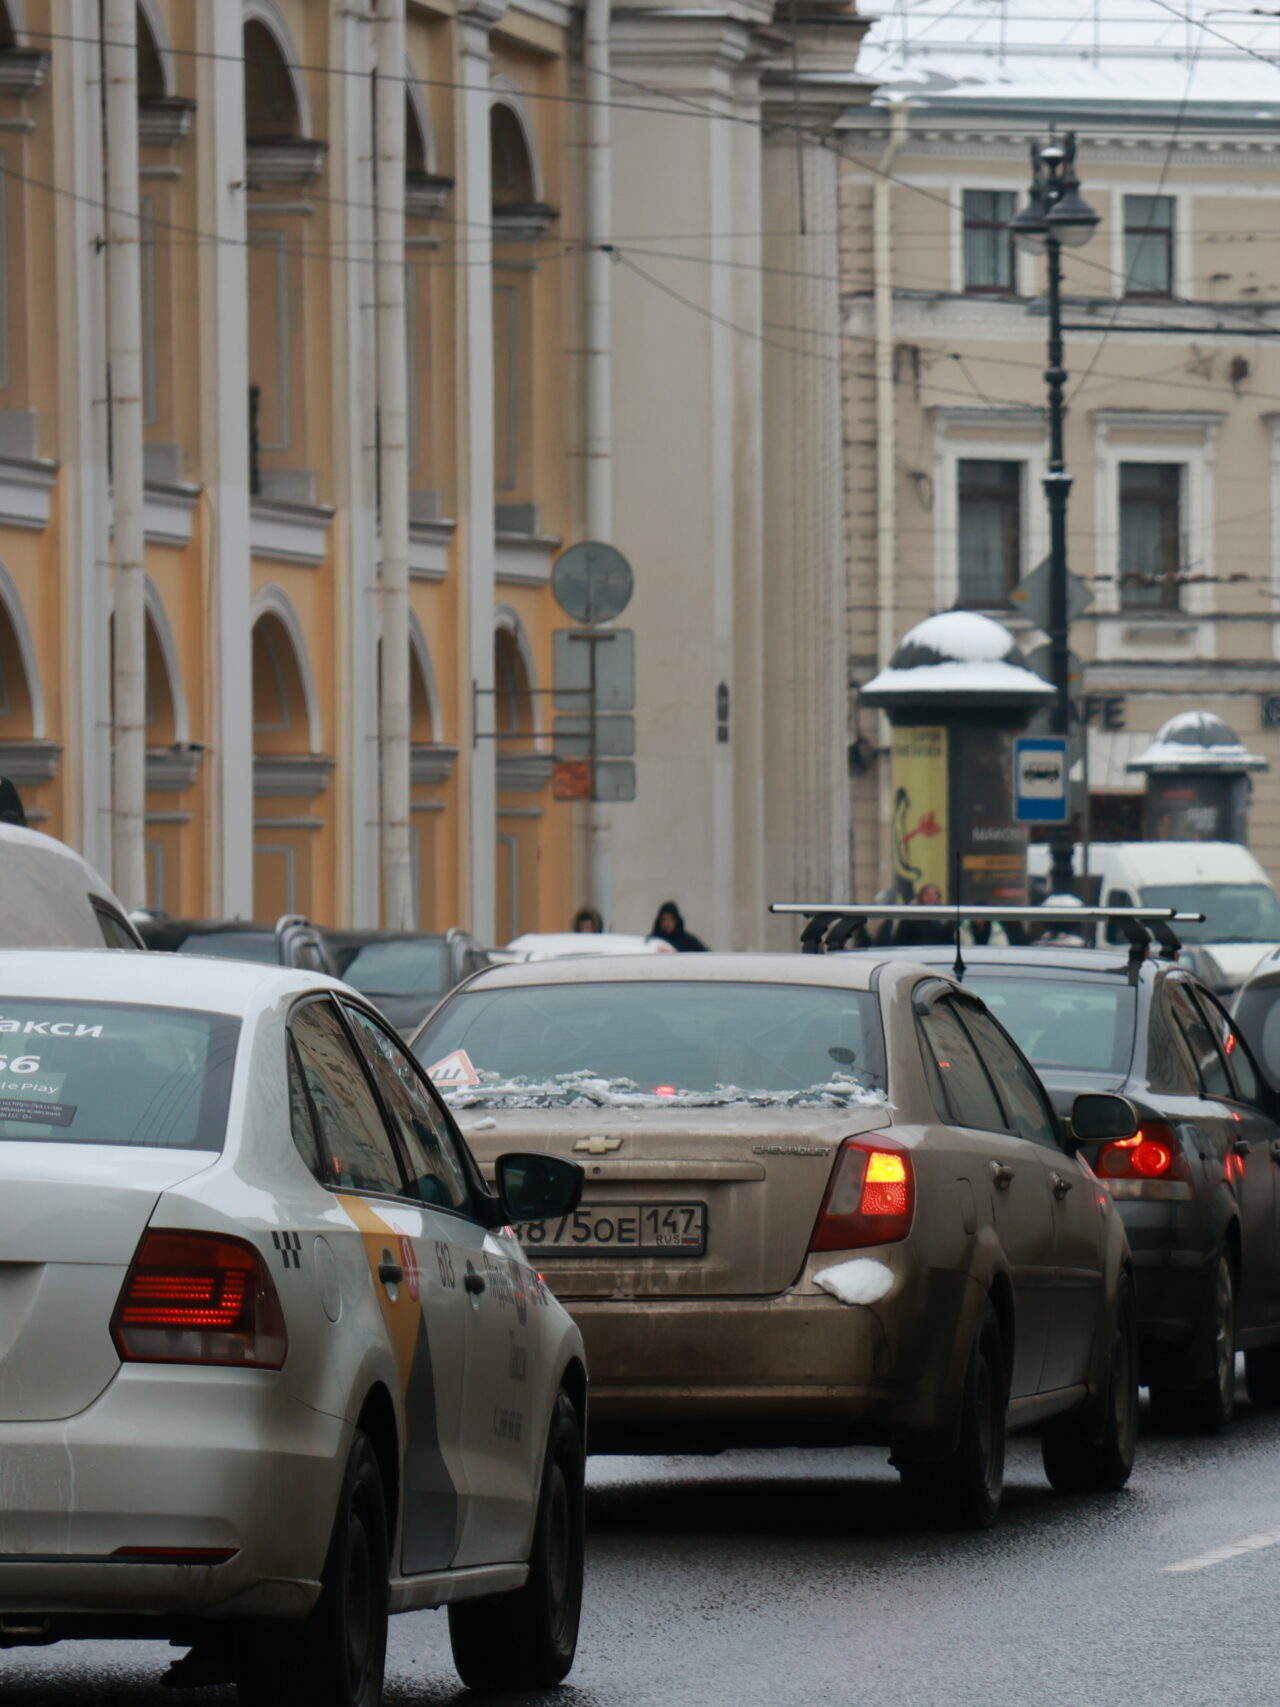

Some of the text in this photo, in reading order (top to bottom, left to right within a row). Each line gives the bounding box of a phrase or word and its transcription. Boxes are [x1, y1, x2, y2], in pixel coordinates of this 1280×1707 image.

[0, 1016, 103, 1038] акси
[752, 1145, 832, 1156] CHEVROLET
[645, 1209, 696, 1234] 147
[656, 1234, 680, 1244] RUS
